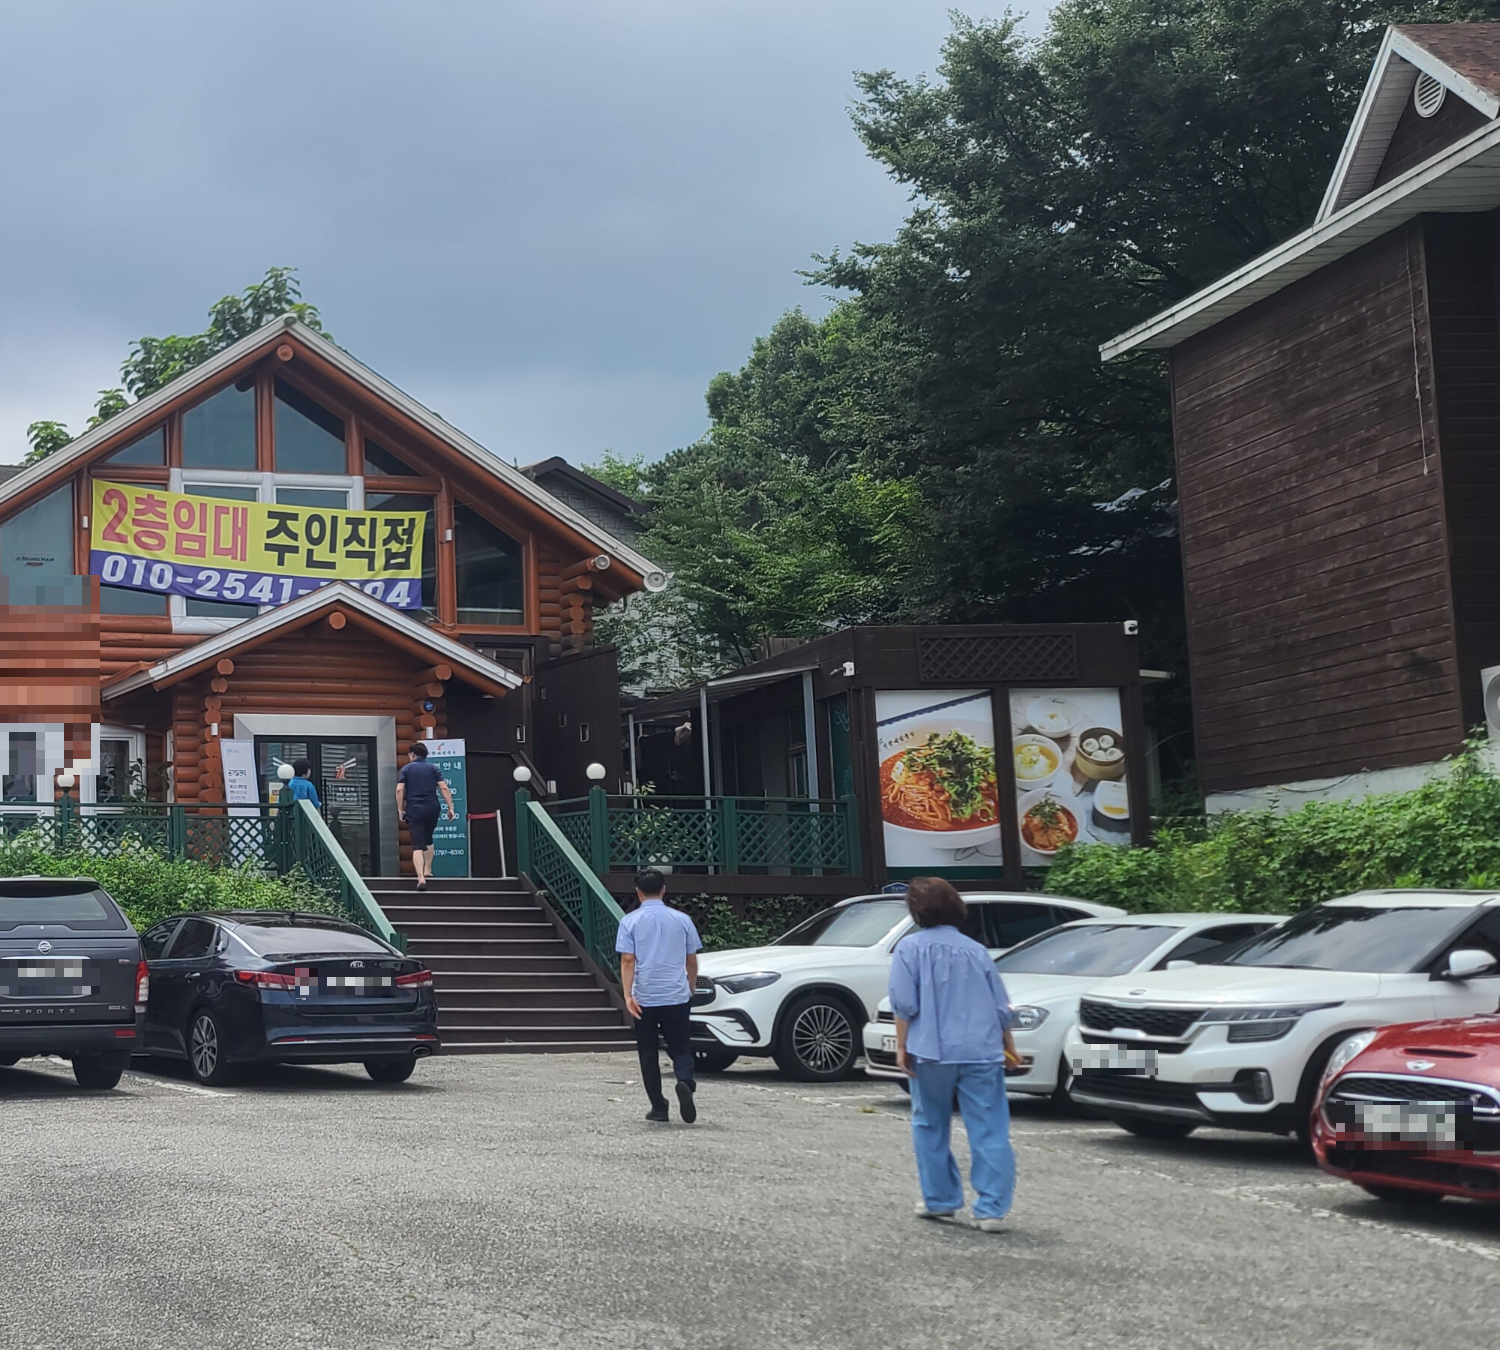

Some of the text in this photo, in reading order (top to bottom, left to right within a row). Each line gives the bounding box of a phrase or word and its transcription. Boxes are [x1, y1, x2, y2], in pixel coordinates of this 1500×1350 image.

[102, 488, 417, 572] 2층임대 주인직접
[102, 554, 411, 608] 010-2541-94
